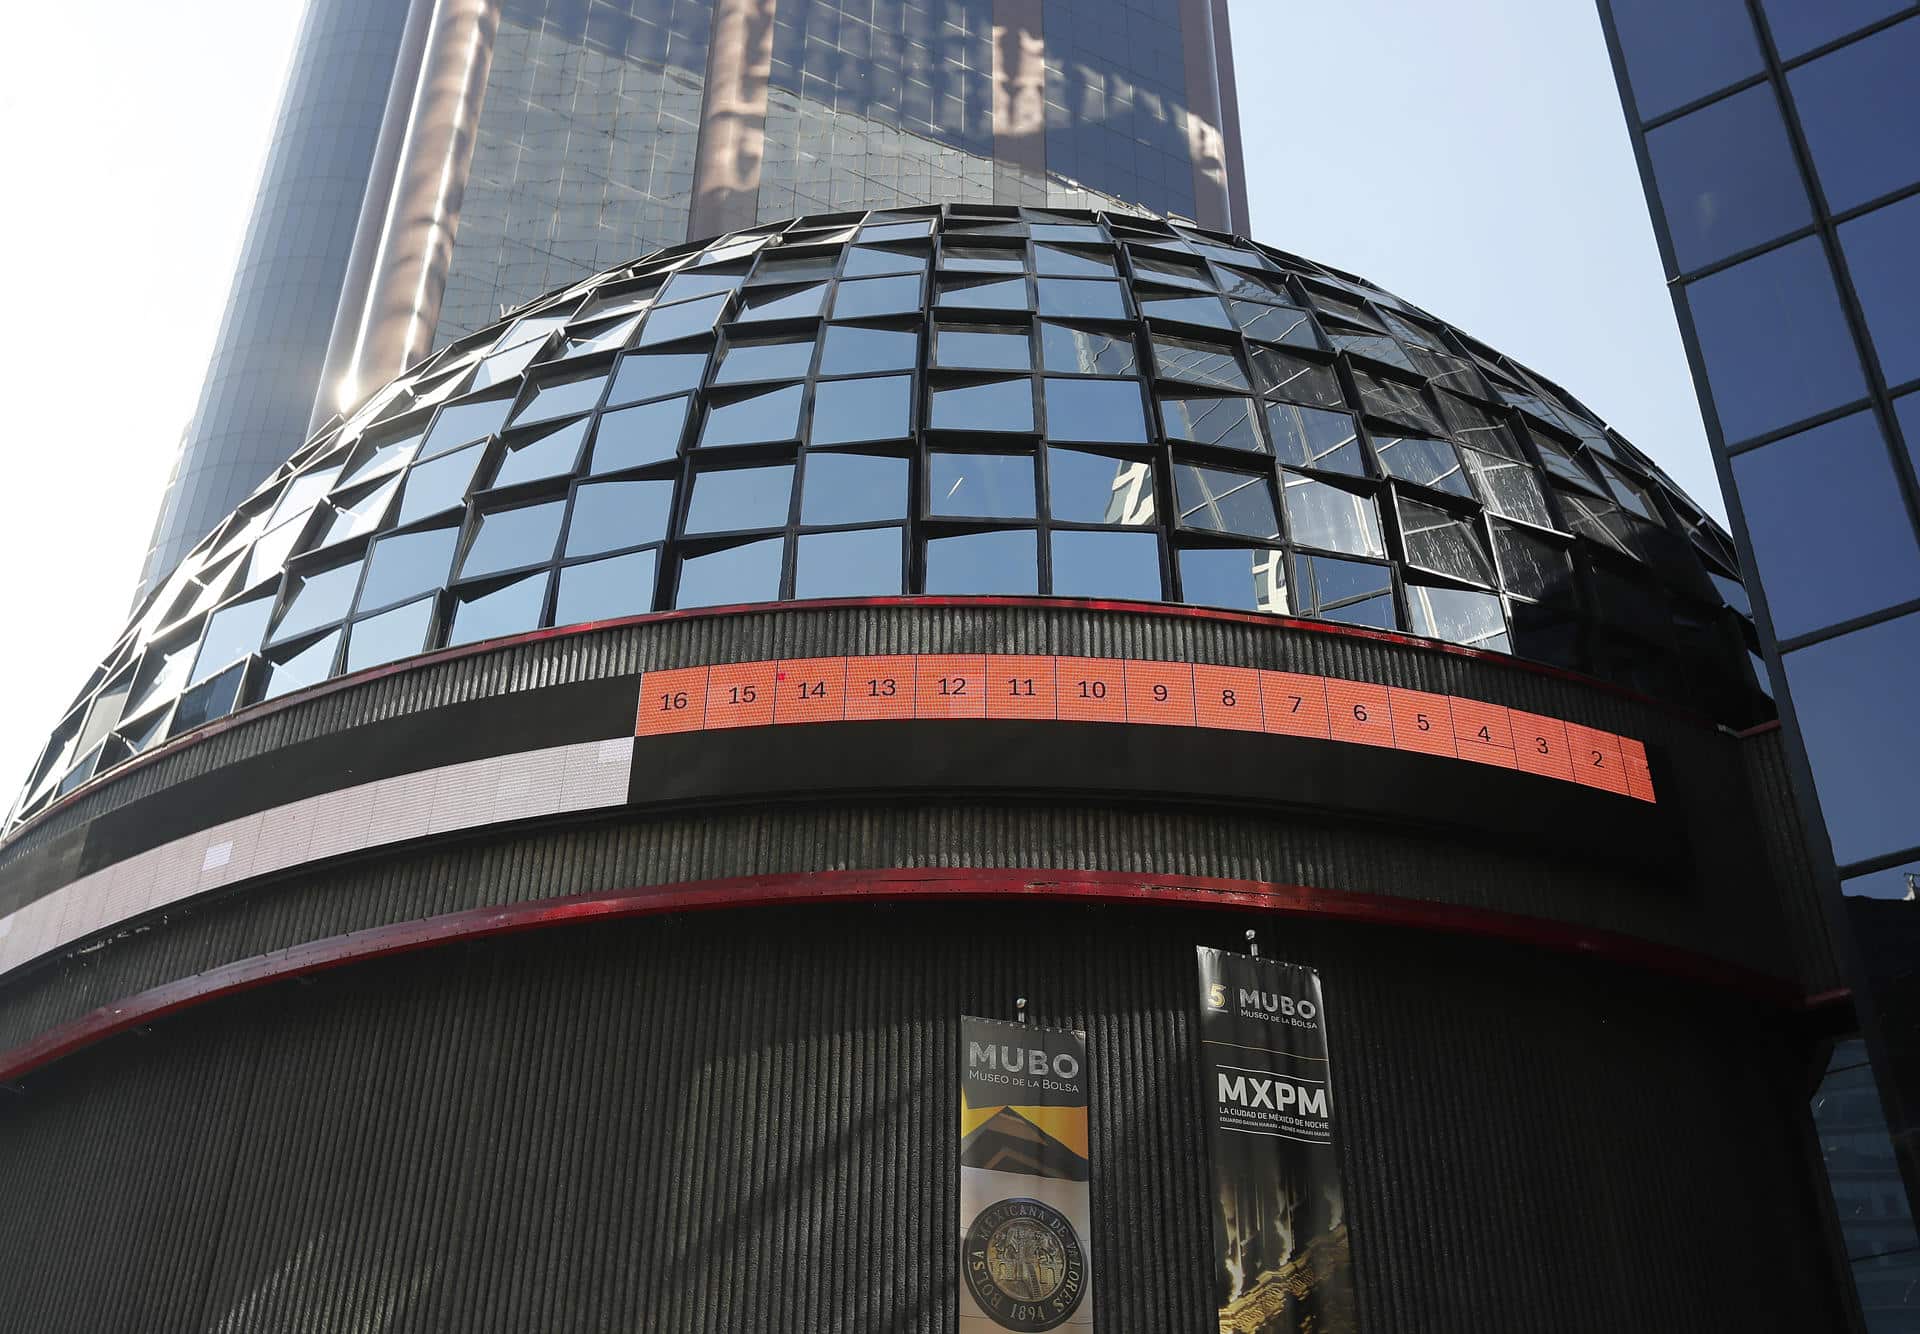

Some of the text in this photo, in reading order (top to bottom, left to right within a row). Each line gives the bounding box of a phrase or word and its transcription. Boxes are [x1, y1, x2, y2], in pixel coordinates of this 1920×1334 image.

[660, 677, 1605, 768] 16 15 14 13 12 11 10 9 8 7 6 5 4 3 2
[1208, 983, 1226, 1008] 5
[1239, 988, 1316, 1019] MUBO
[968, 1041, 1079, 1079] MUBO
[1218, 1073, 1329, 1119] MXPM
[1219, 1106, 1229, 1114] LA
[1230, 1108, 1256, 1119] CIUDAD
[1257, 1112, 1267, 1120] DE
[1294, 1117, 1304, 1126] DE
[1304, 1120, 1329, 1130] NOCHE
[971, 1250, 1001, 1309] BOLSA
